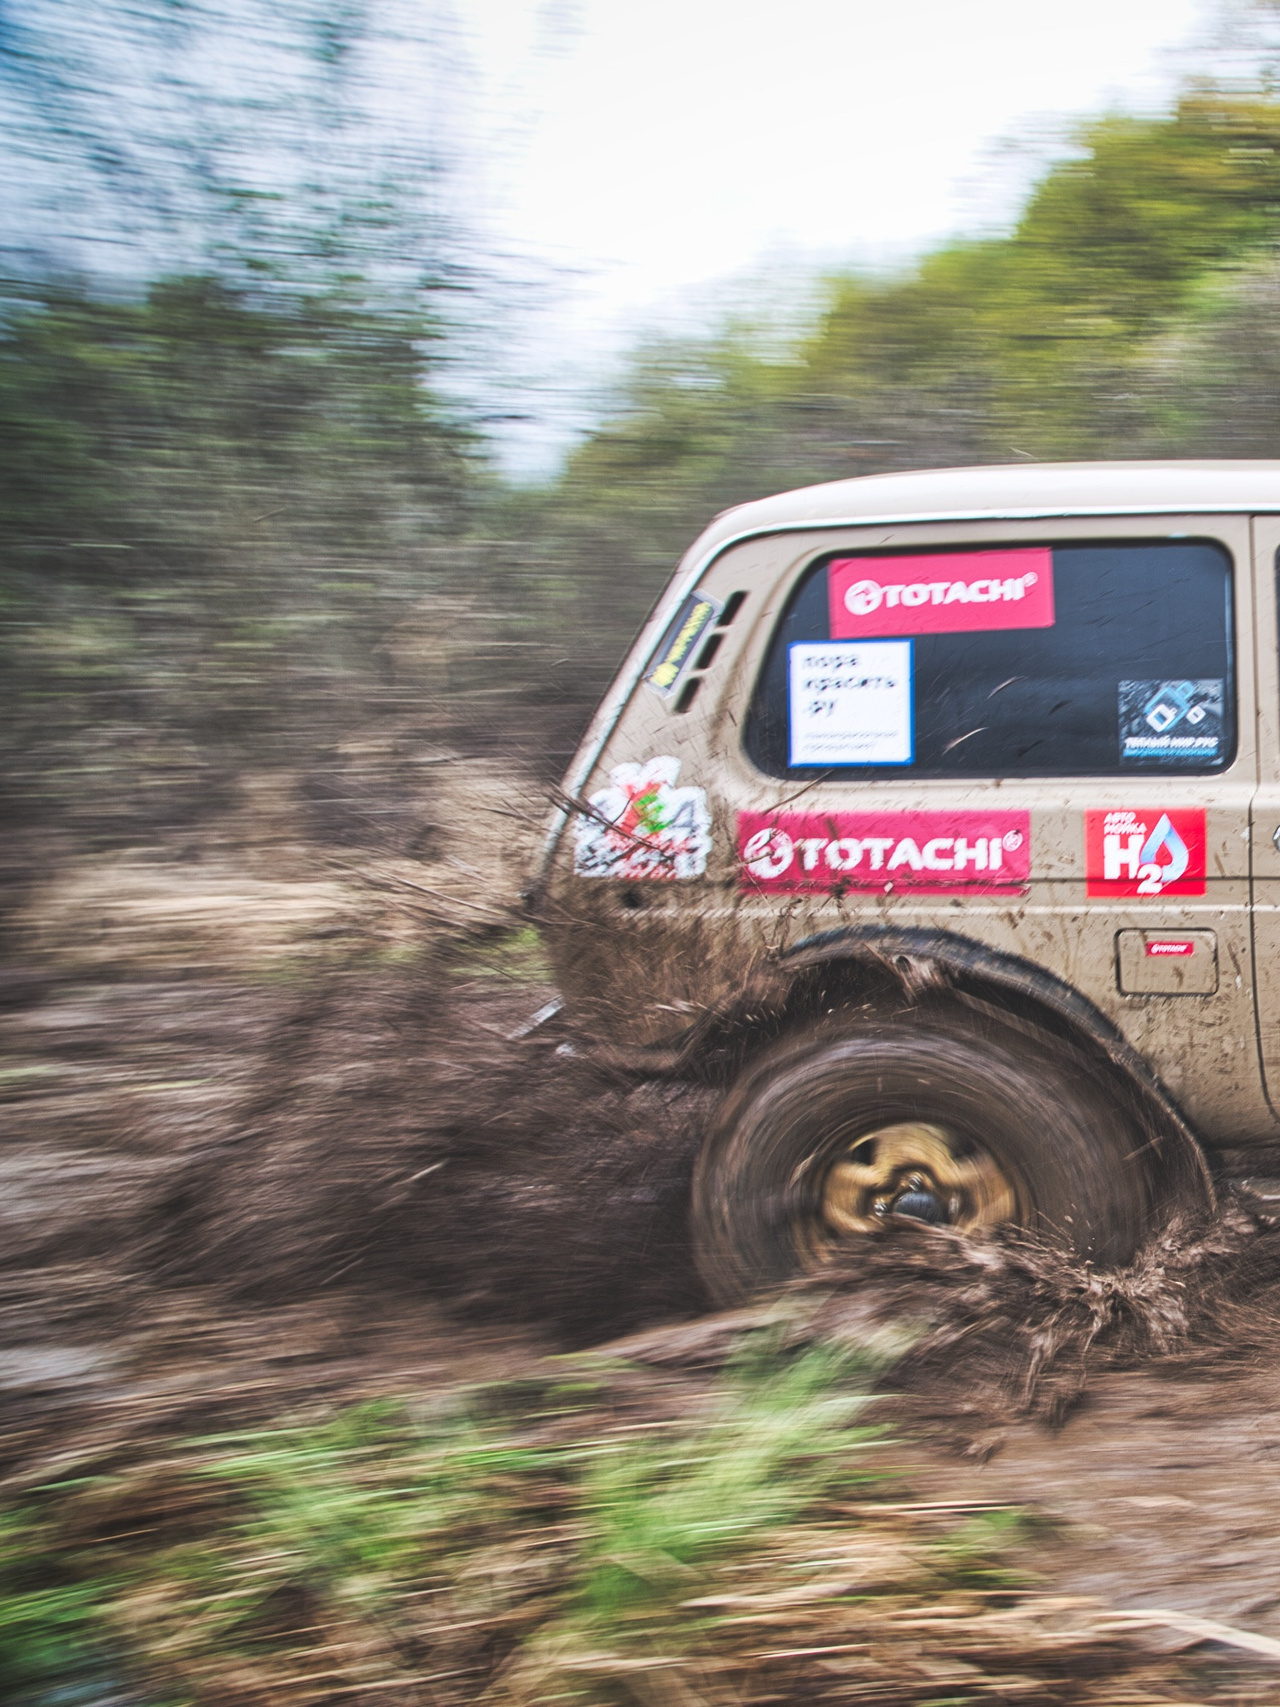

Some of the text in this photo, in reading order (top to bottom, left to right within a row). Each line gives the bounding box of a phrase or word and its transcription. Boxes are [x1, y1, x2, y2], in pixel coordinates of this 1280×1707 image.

[881, 577, 1025, 608] TOTACHI
[1103, 812, 1136, 825] АВТО
[793, 837, 1003, 871] TOTACHI
